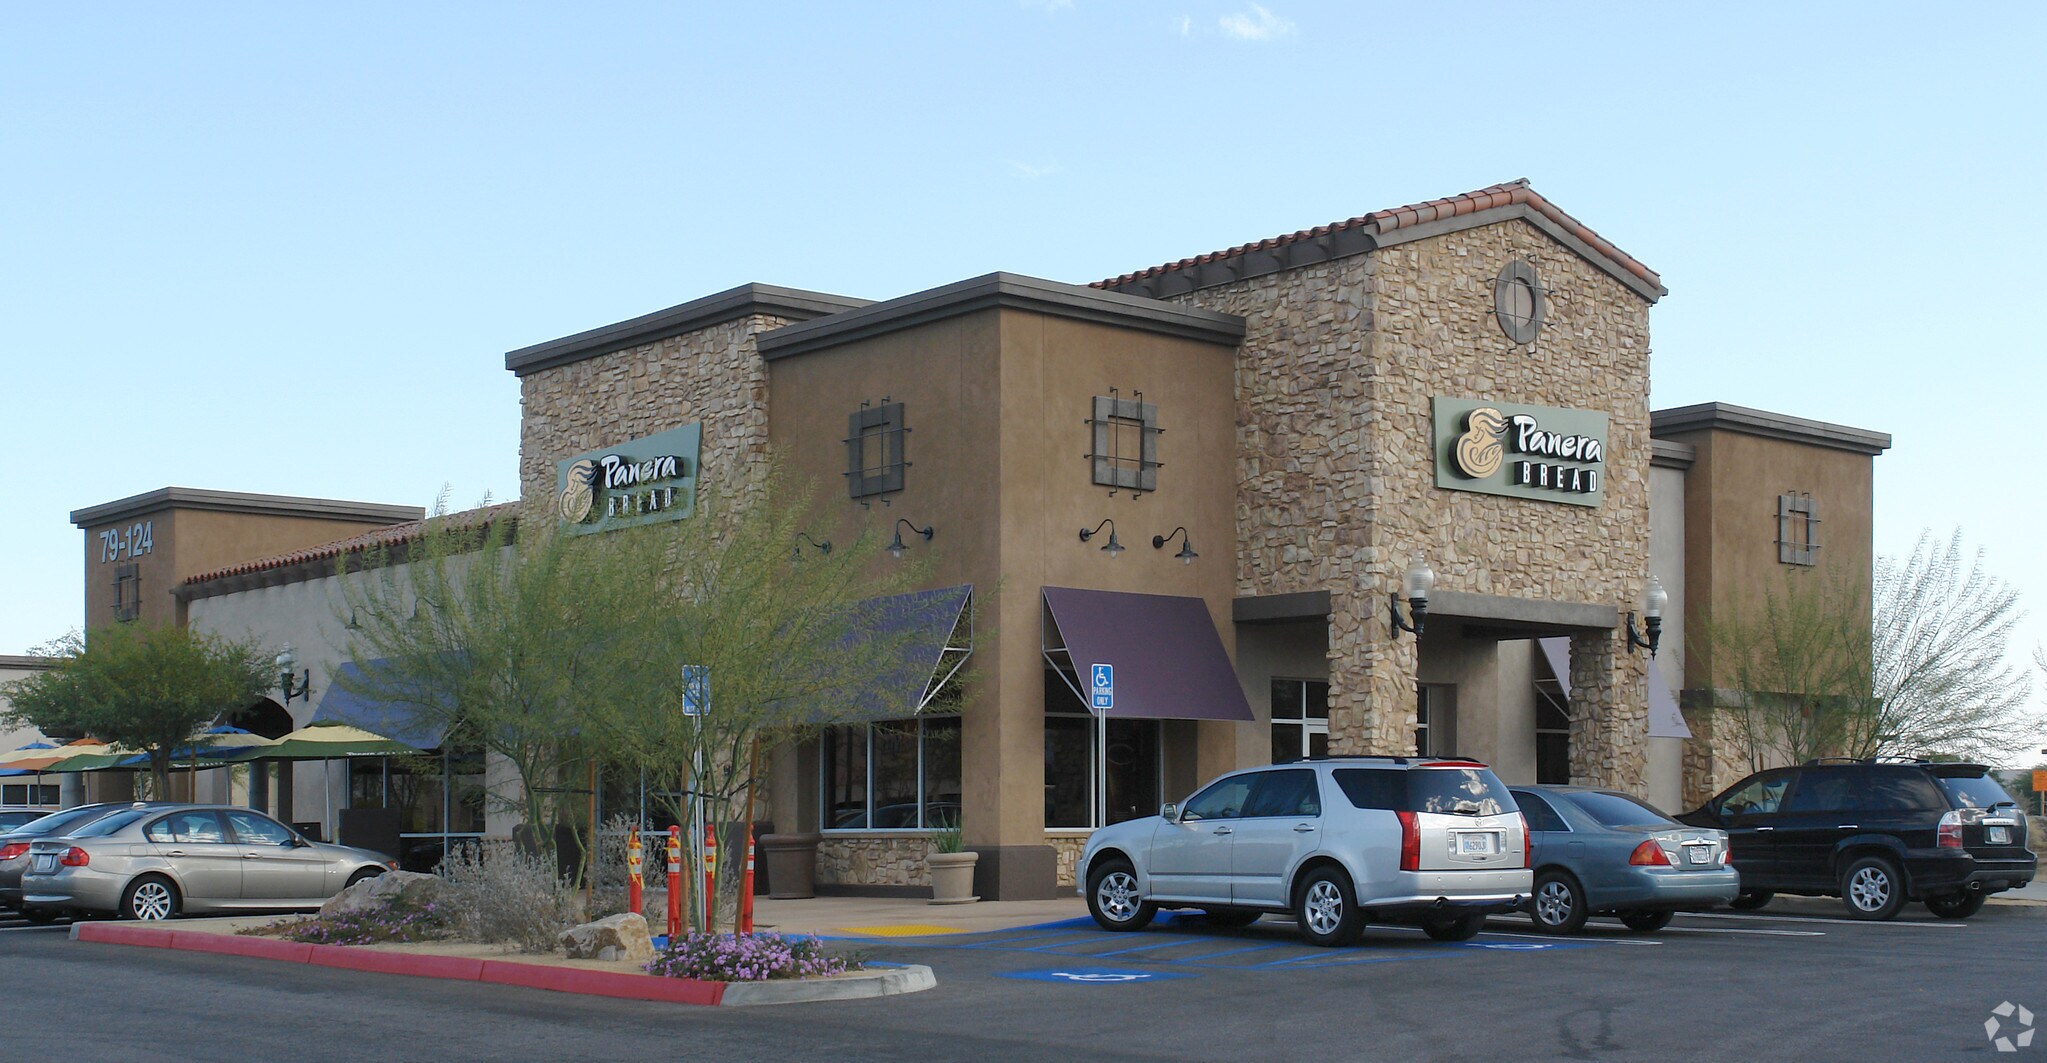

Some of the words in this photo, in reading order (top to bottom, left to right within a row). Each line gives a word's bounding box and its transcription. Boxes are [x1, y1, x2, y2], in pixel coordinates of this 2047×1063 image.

[1512, 413, 1602, 462] Panera
[600, 454, 676, 489] Panera
[1520, 461, 1598, 493] BREAD
[99, 521, 153, 563] 79-124
[1096, 696, 1109, 706] ONLY
